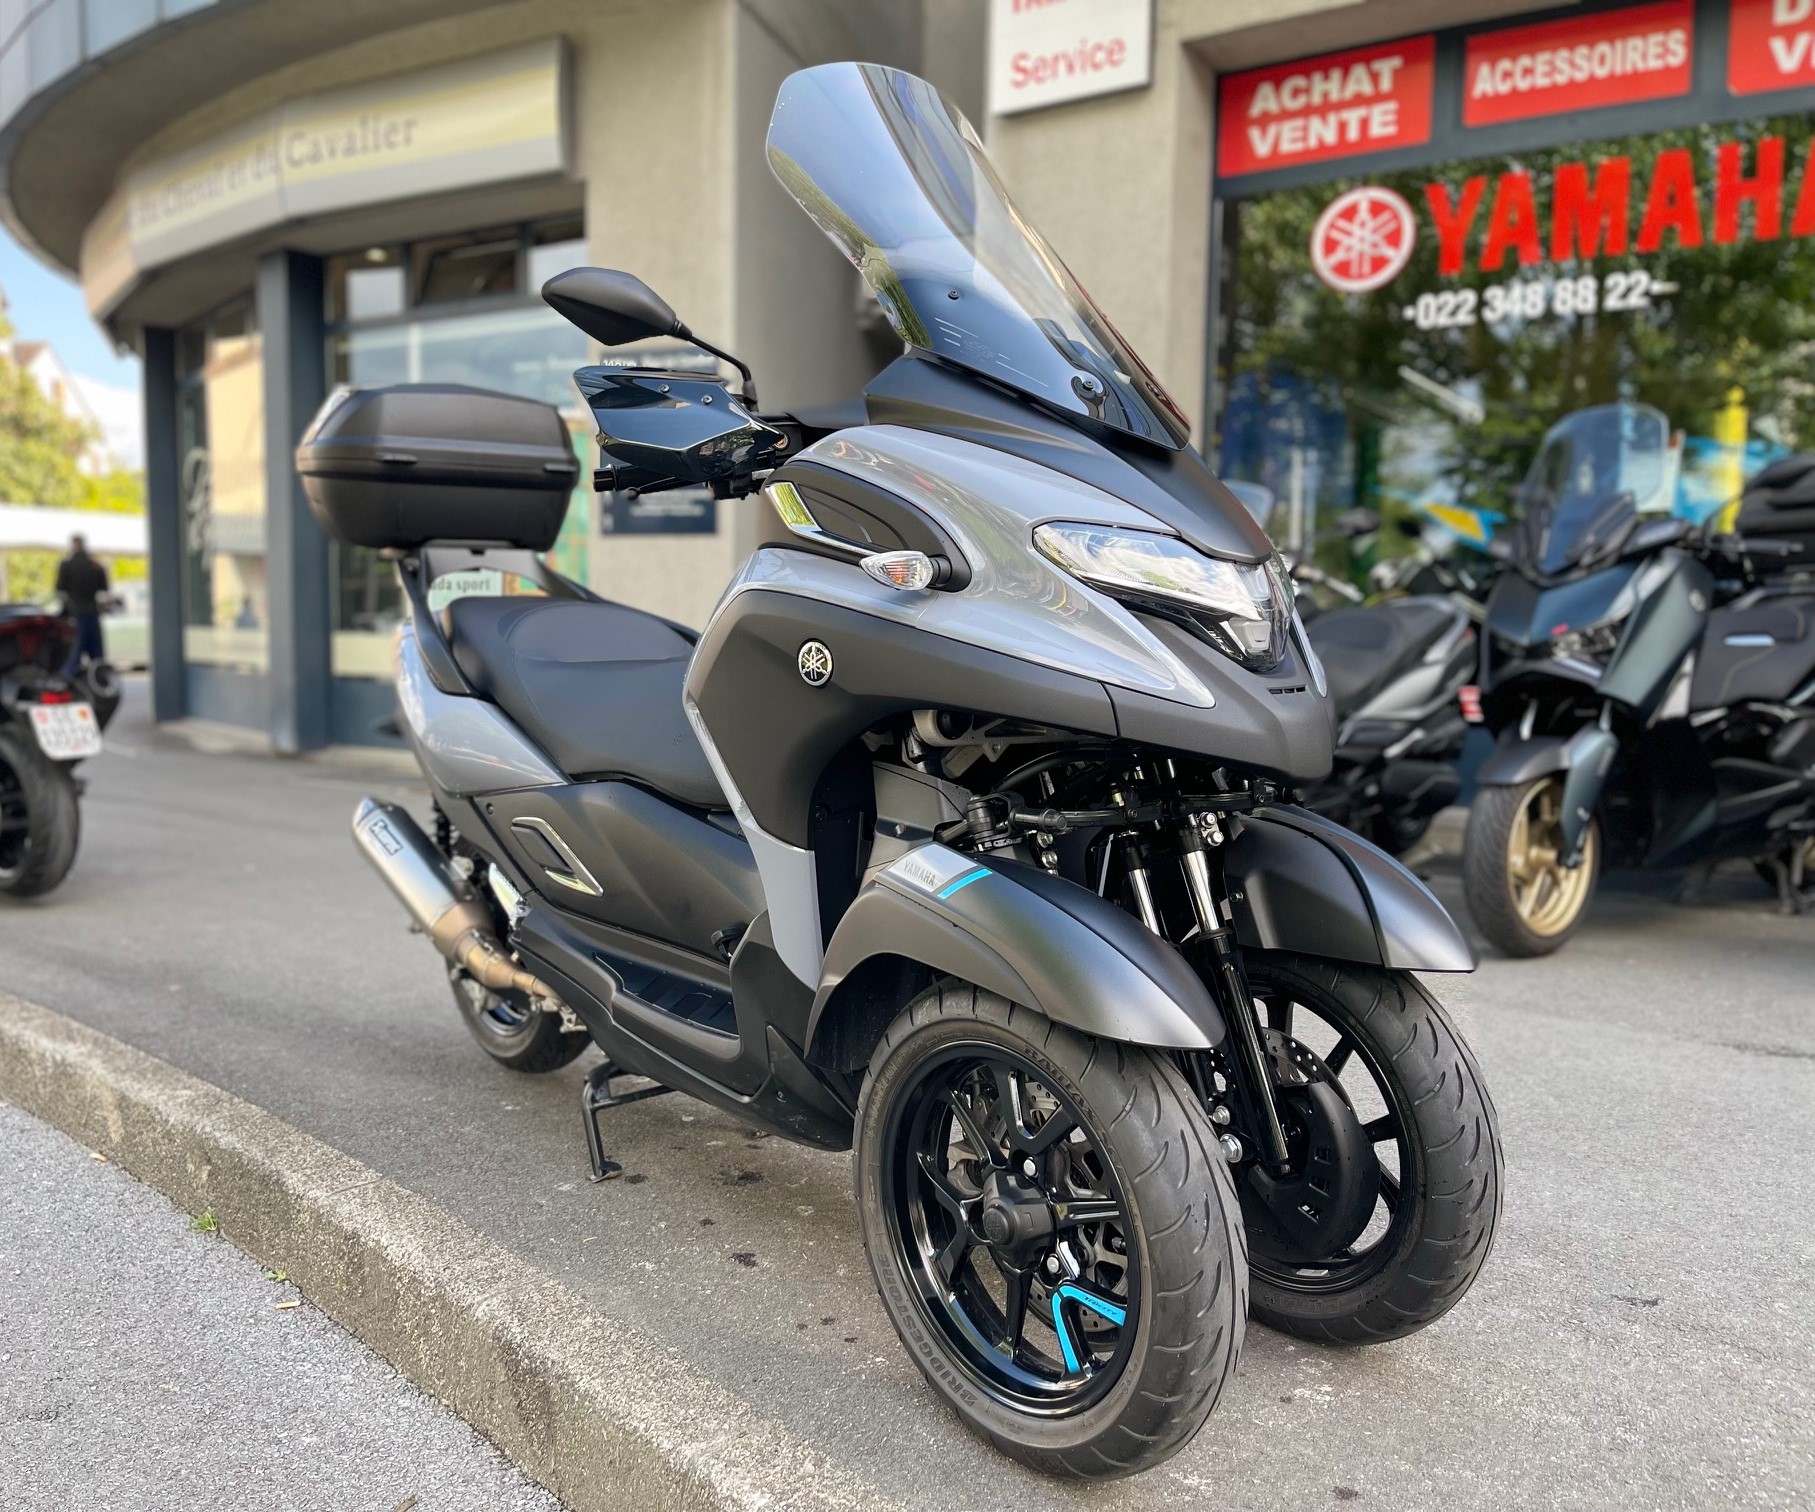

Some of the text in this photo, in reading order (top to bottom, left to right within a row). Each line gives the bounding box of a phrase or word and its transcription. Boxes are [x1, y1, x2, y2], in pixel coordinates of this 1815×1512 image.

[1010, 37, 1127, 90] Service
[1248, 55, 1404, 118] ACHAT
[1472, 28, 1688, 99] ACCESSOIRES
[285, 113, 417, 170] Cavalier
[1247, 100, 1399, 159] VENTE
[1415, 269, 1652, 330] 022 348 88 22
[456, 578, 490, 593] sport
[903, 859, 937, 886] YAMAHA
[876, 1252, 978, 1408] BRIDGESTONE
